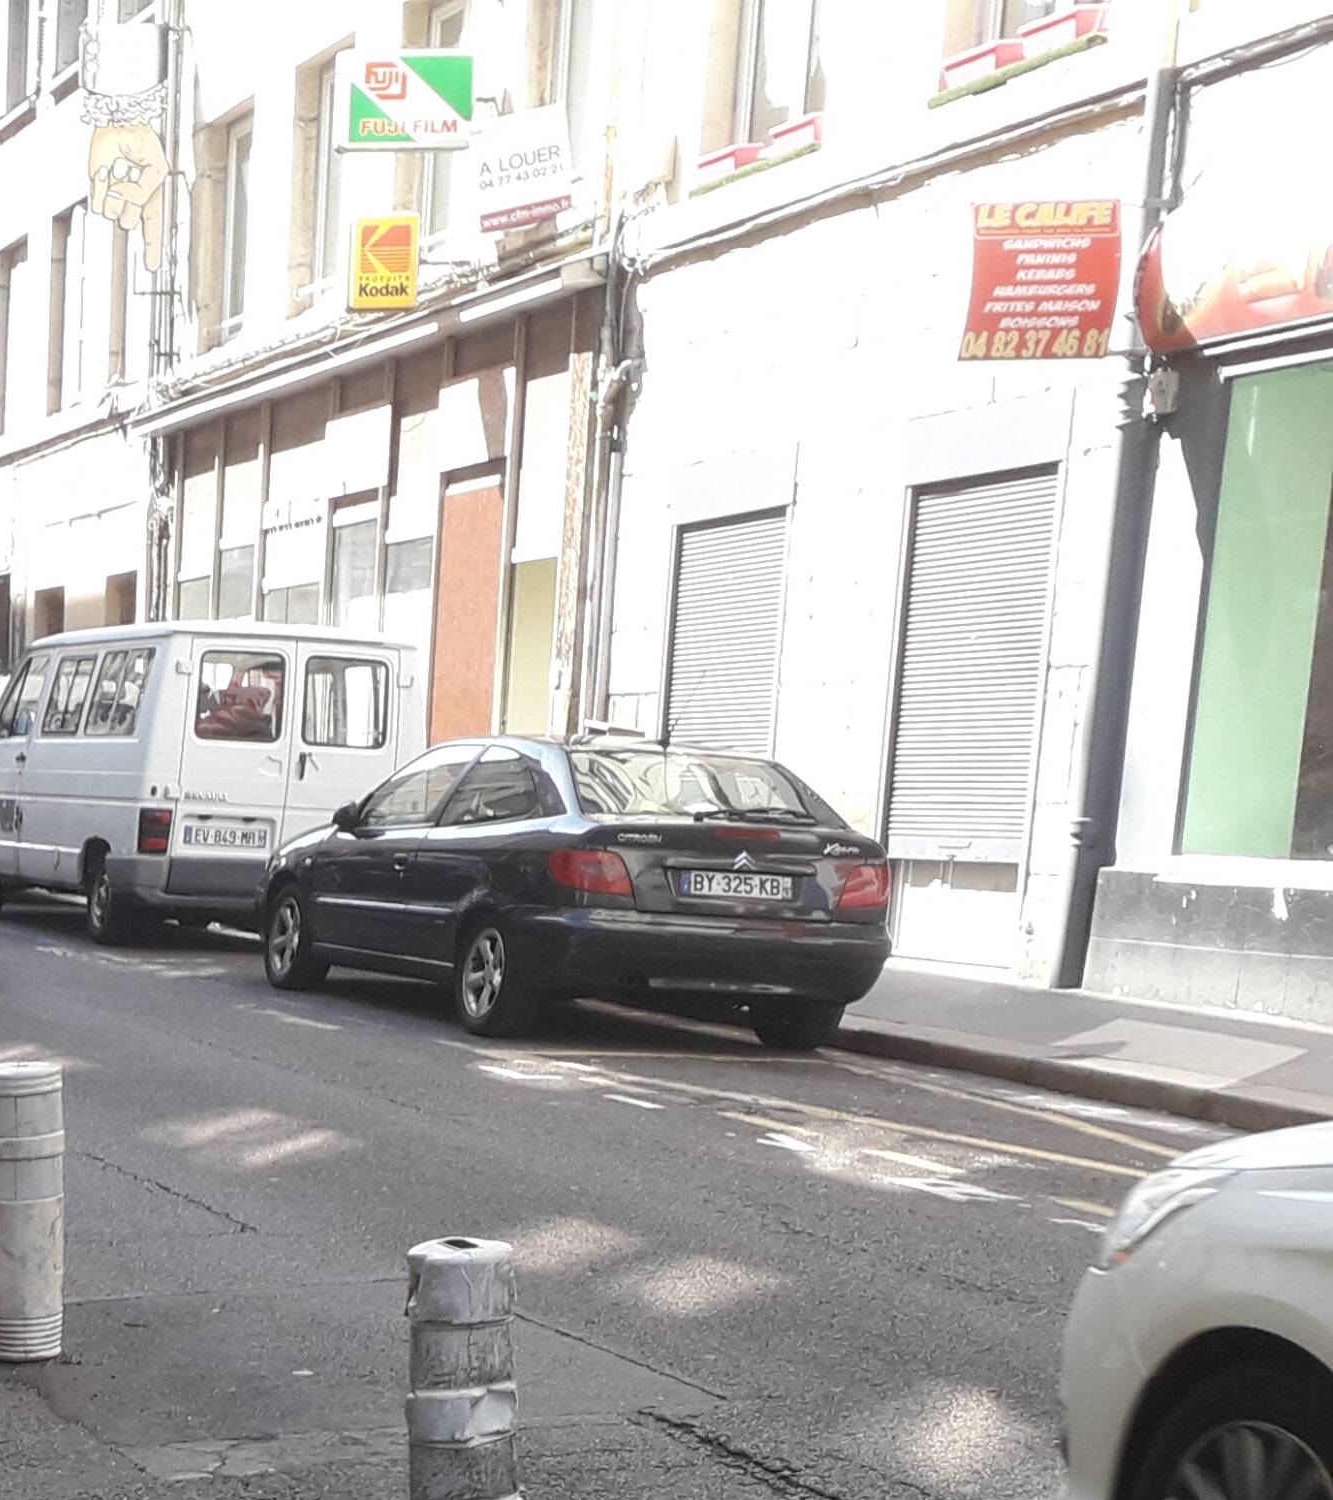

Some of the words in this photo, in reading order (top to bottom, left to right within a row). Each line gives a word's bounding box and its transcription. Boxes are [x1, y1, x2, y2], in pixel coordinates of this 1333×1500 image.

[365, 62, 407, 100] FUJI
[361, 119, 406, 135] FUJI
[413, 119, 458, 134] FILM
[480, 161, 492, 177] A
[498, 144, 561, 172] LOUER
[479, 178, 494, 190] 04
[498, 174, 511, 186] 77
[515, 171, 530, 182] 43
[977, 203, 1013, 229] LE
[1015, 201, 1114, 228] CALIFE
[1002, 237, 1092, 250] SANDWICHS
[1015, 252, 1078, 265] PANINIS
[1015, 268, 1077, 281] KEBABS
[358, 281, 410, 297] Kodak
[992, 283, 1097, 297] HAMBURGERS
[984, 301, 1035, 313] FRITES
[1036, 299, 1102, 312] MAISON
[999, 315, 1080, 329] BOISSONS
[961, 331, 988, 358] 04
[991, 330, 1020, 357] 82
[1022, 329, 1052, 357] 37
[1051, 328, 1081, 357] 46
[1083, 327, 1110, 356] 81
[692, 872, 783, 898] BY-325-KB
